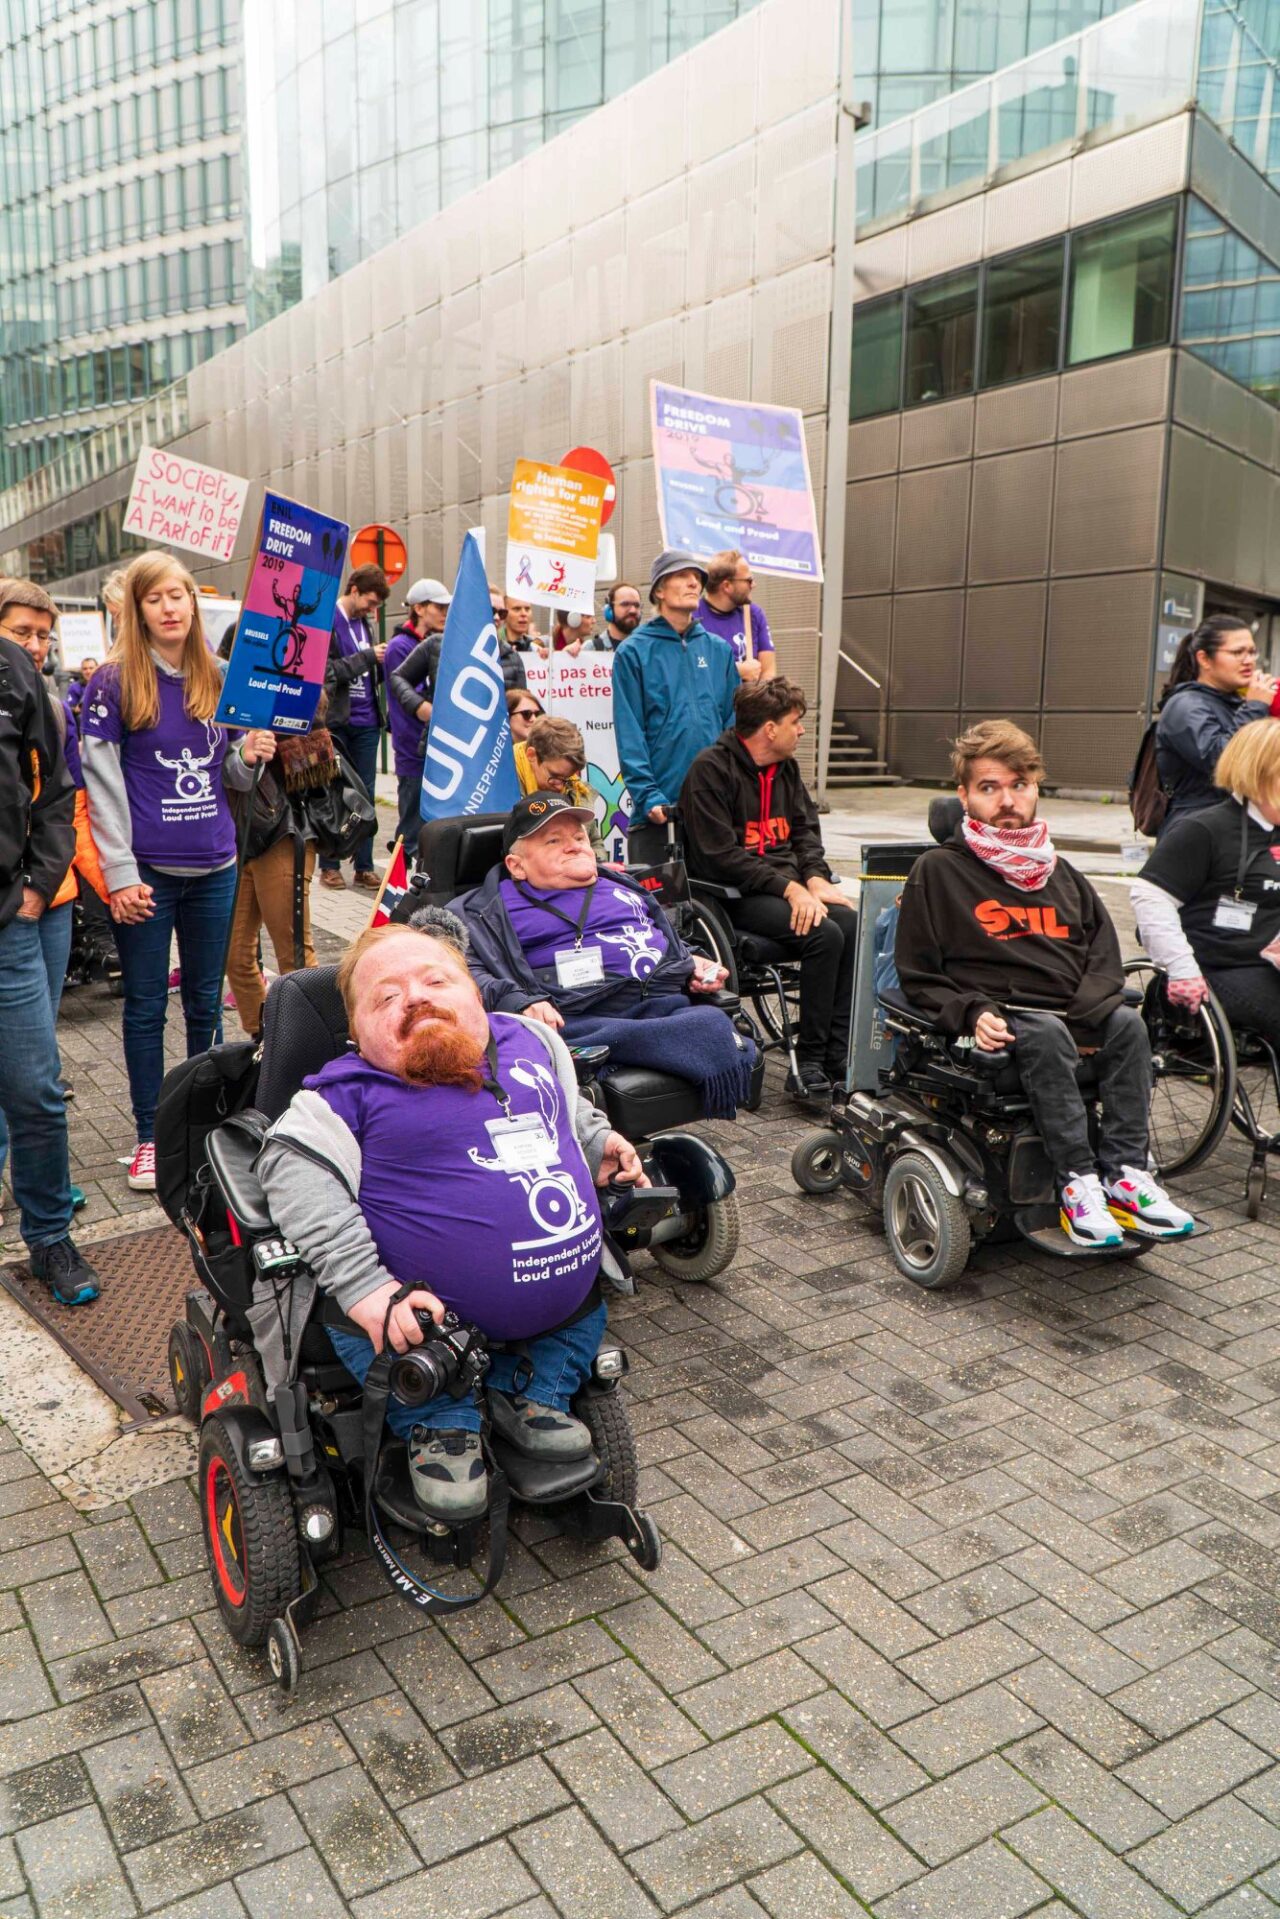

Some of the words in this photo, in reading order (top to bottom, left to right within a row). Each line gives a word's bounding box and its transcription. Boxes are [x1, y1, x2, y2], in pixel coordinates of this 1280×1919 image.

[663, 403, 731, 429] FREEDOM
[663, 417, 707, 435] DRIVE
[537, 471, 583, 491] Human
[515, 481, 555, 498] rights
[559, 488, 576, 502] for
[132, 479, 150, 503] I
[199, 500, 214, 523] to
[218, 504, 238, 530] be
[127, 506, 143, 530] A
[269, 518, 312, 546] FREEDOM
[724, 524, 745, 536] and
[747, 527, 780, 541] Proud
[265, 537, 294, 557] DRIVE
[262, 555, 285, 572] 2019
[560, 668, 587, 682] pas
[248, 677, 268, 690] Loud
[267, 682, 282, 693] and
[281, 683, 303, 696] Proud
[579, 683, 612, 698] être
[162, 806, 202, 814] Independent
[184, 812, 199, 821] and
[201, 808, 218, 819] Proud
[975, 899, 1069, 939] STIL
[512, 1245, 580, 1268] Independent
[513, 1266, 550, 1283] Loud
[555, 1257, 578, 1276] and
